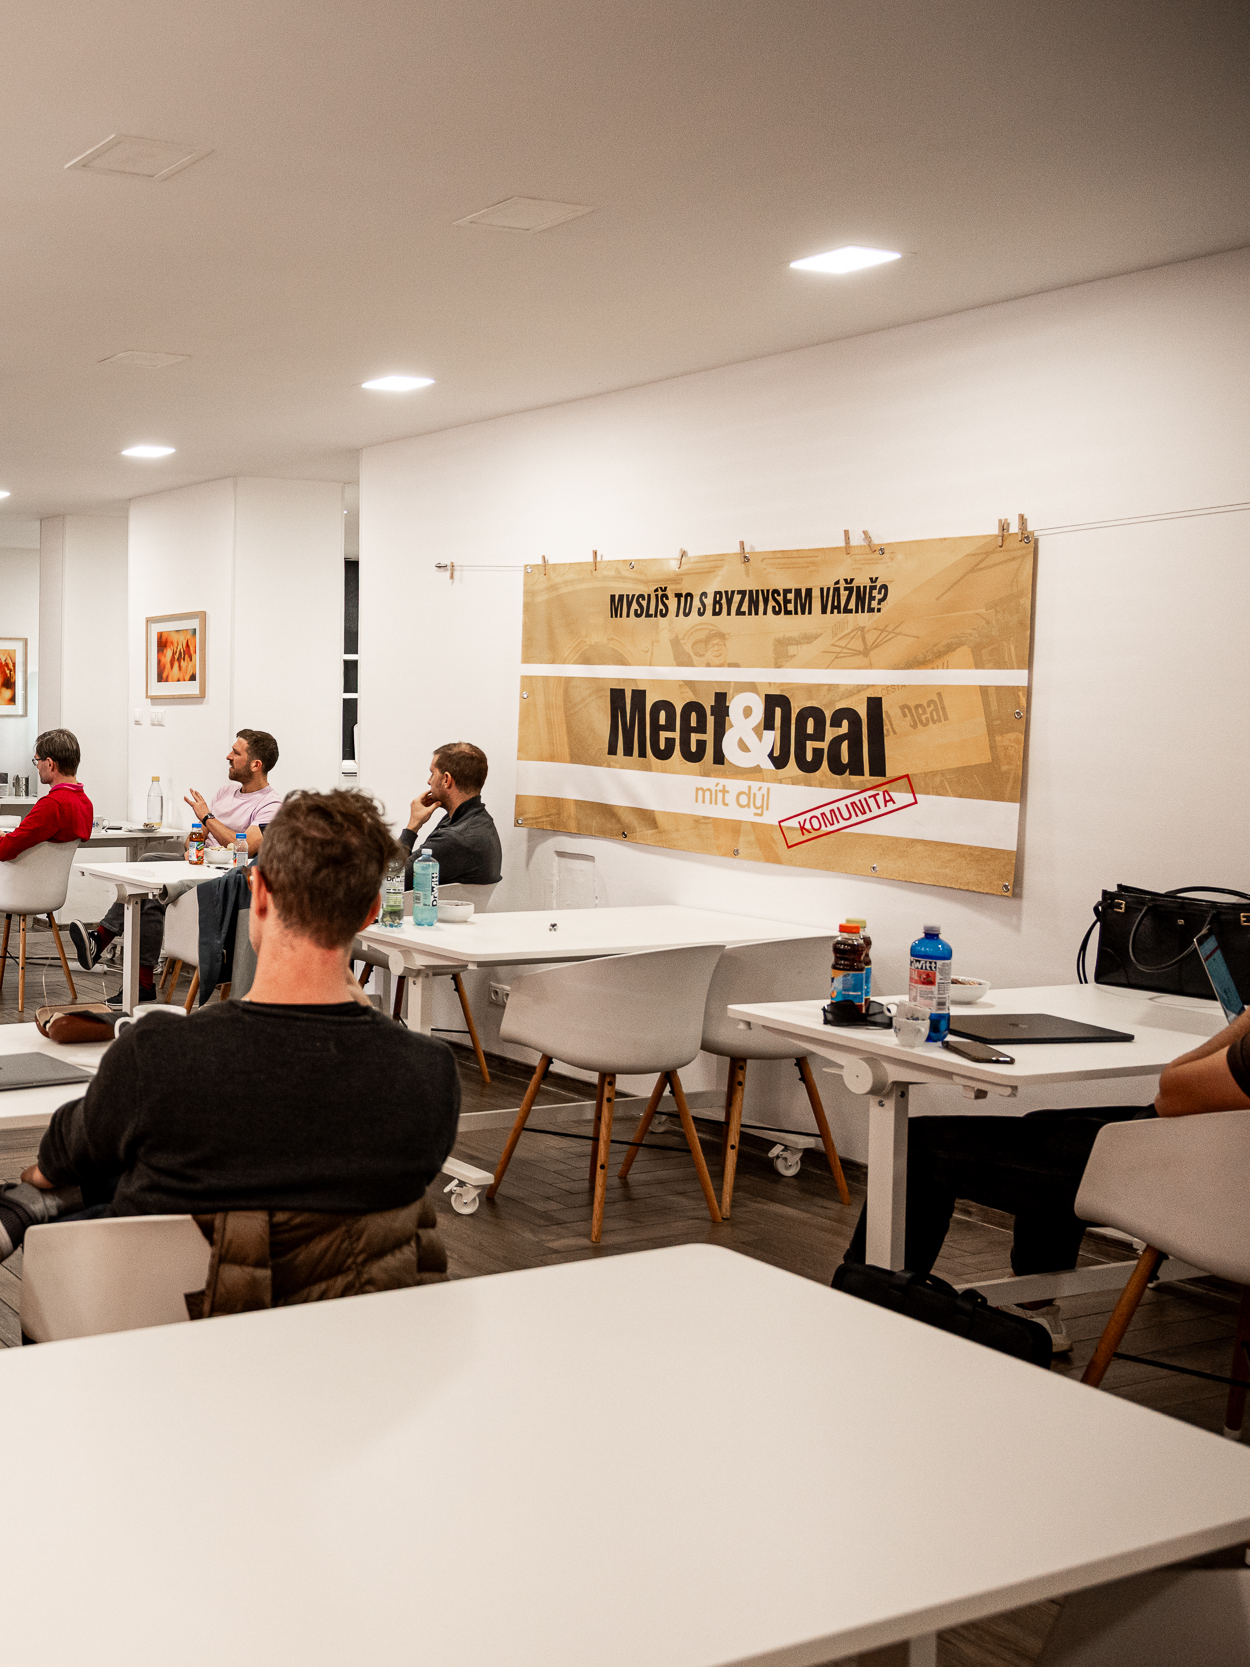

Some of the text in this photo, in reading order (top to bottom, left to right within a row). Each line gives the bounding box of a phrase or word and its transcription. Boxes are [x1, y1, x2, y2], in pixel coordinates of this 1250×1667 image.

[609, 577, 889, 618] MYSLÍŠ TO S BYZNYSEM VÁŽNĚ?
[695, 782, 771, 818] mít dýl
[797, 789, 897, 837] KOMUNITA
